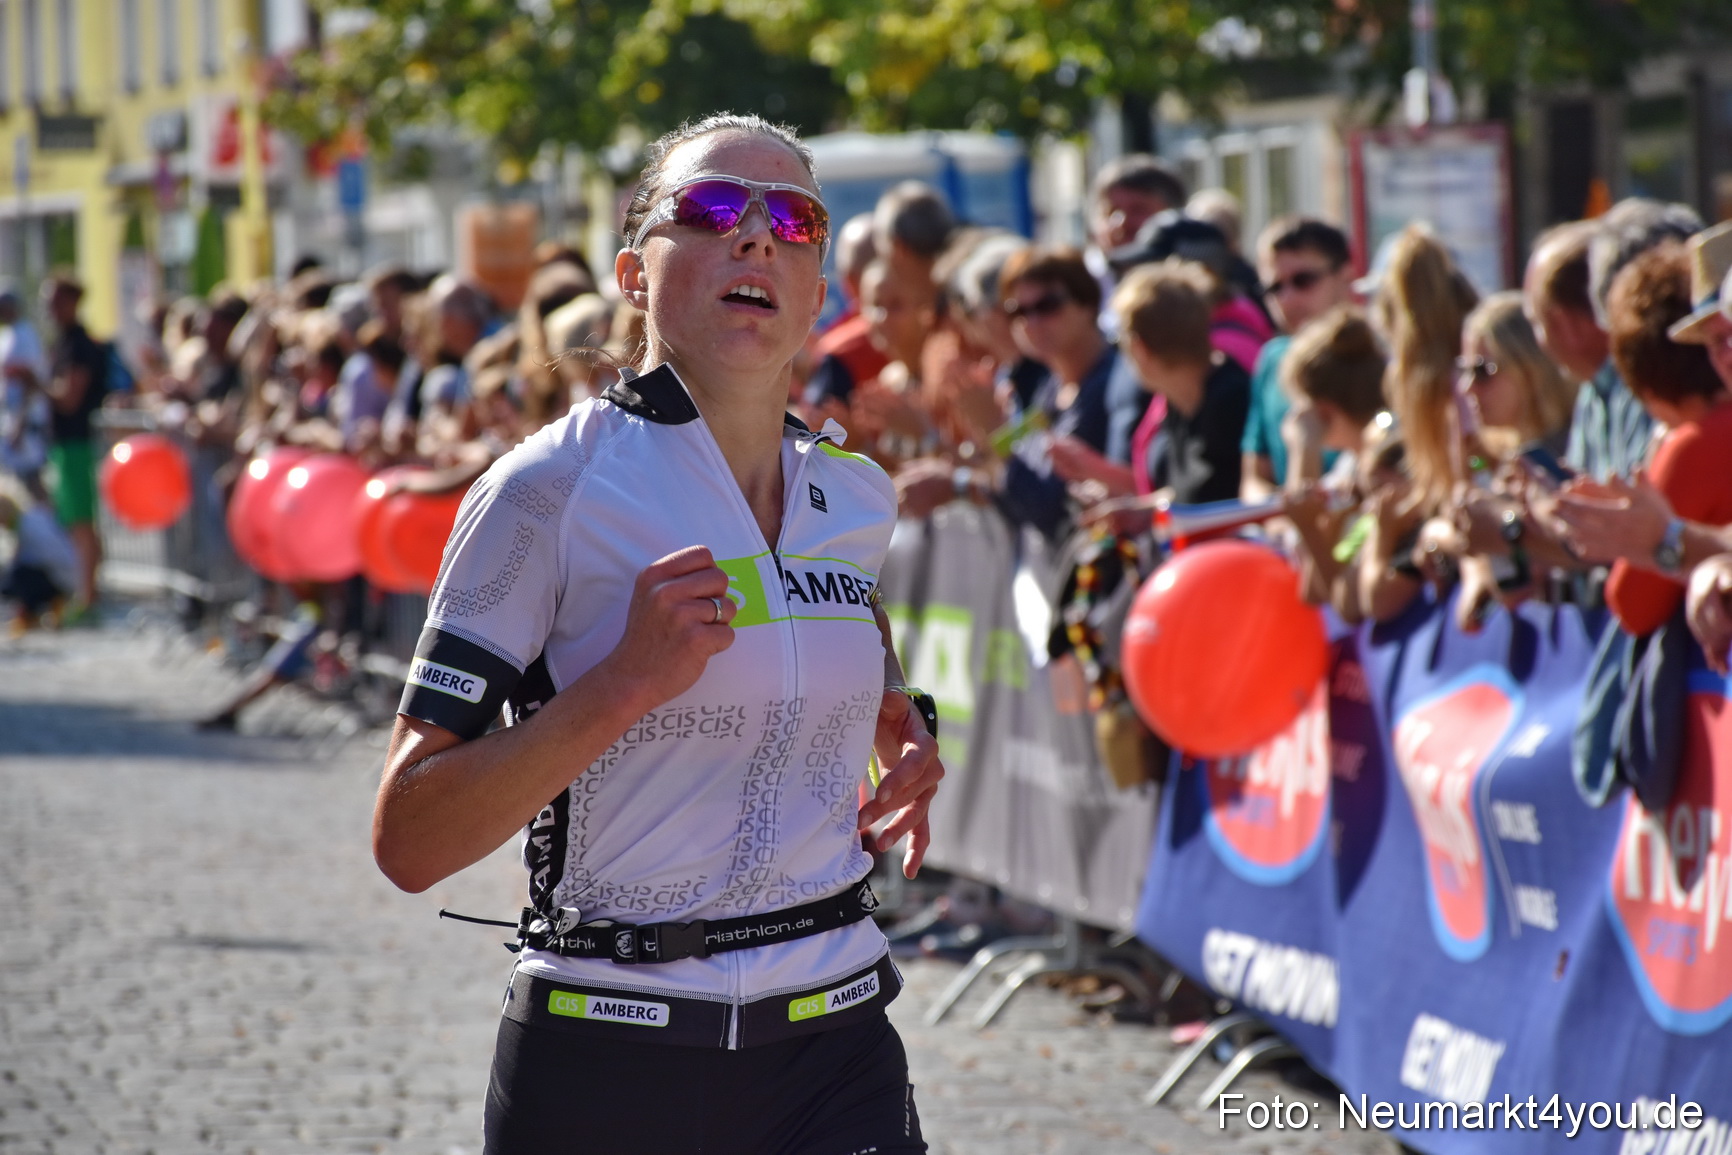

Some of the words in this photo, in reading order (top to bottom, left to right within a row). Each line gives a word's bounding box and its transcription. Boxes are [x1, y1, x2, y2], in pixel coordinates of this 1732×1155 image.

[413, 665, 475, 694] AMBERG
[556, 996, 578, 1012] CIS
[592, 1001, 658, 1021] AMBERG
[796, 998, 819, 1016] CIS
[831, 977, 876, 1008] AMBERG
